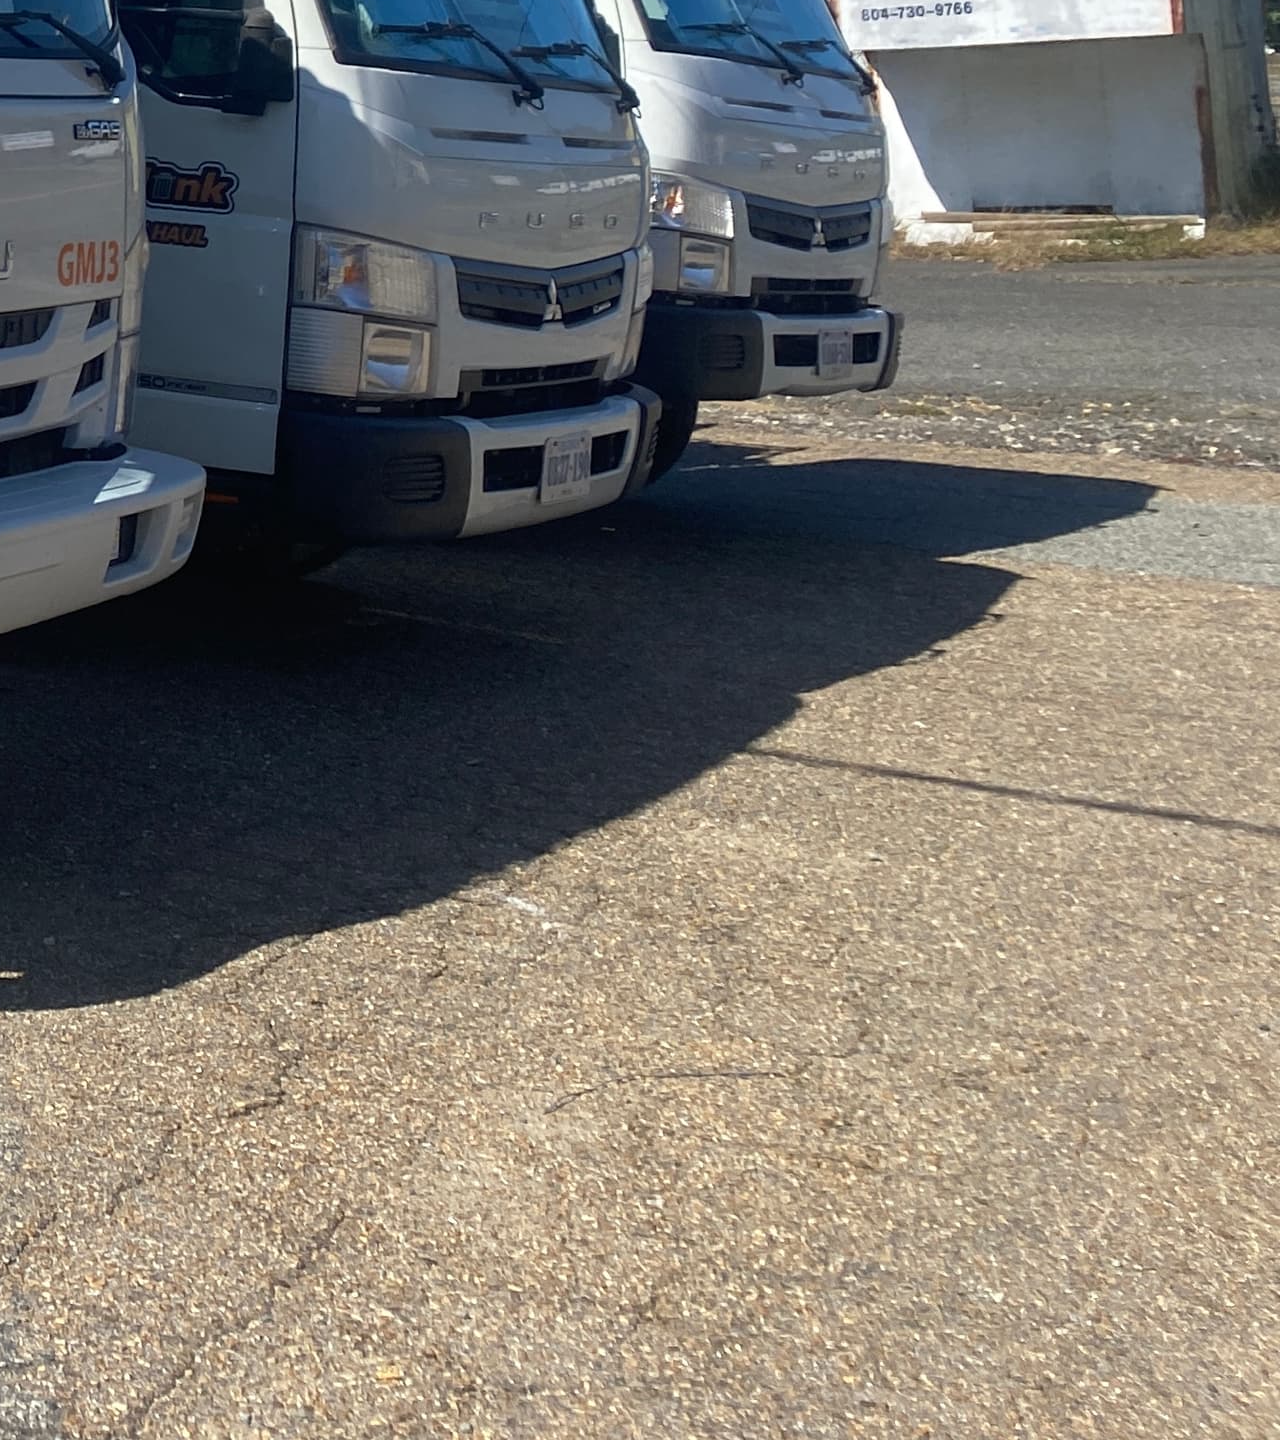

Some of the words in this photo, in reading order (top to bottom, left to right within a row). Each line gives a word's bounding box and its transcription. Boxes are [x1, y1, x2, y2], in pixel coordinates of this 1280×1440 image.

[479, 211, 618, 230] FUSO
[150, 222, 207, 246] HAUL
[56, 240, 120, 287] GMJ3
